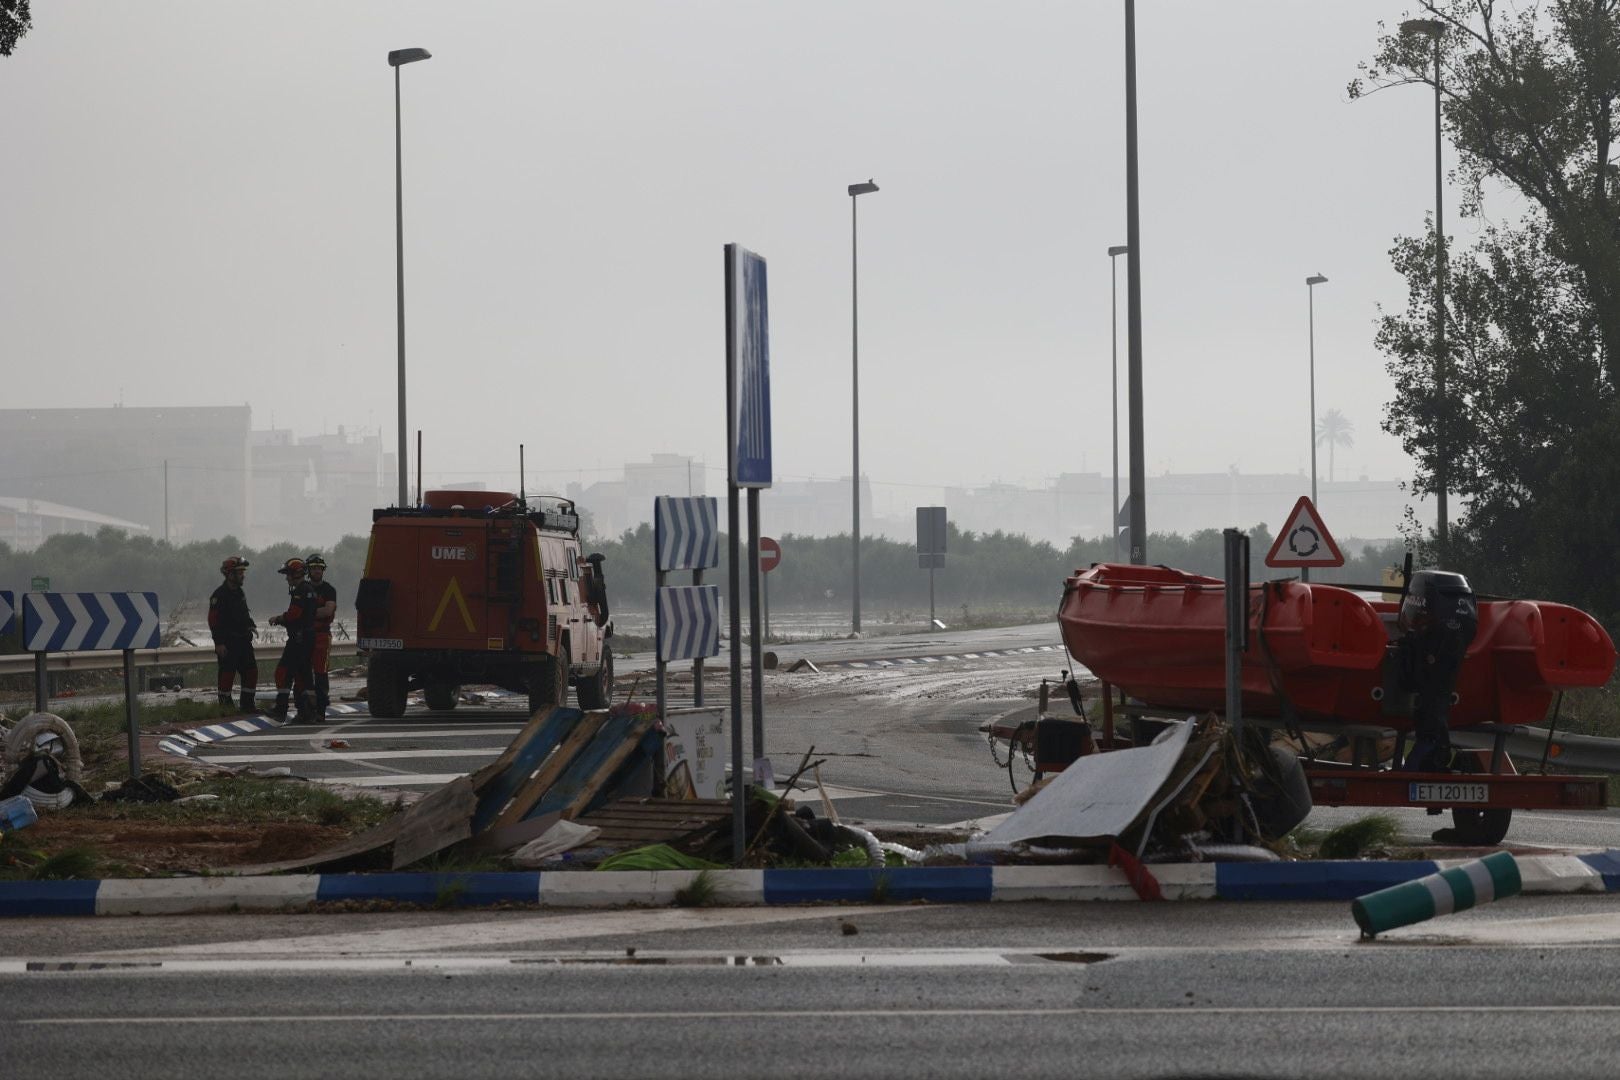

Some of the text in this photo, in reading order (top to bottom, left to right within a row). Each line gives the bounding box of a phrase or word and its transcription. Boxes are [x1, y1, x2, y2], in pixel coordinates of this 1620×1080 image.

[431, 546, 467, 560] UME
[1418, 785, 1485, 800] ET 120113
